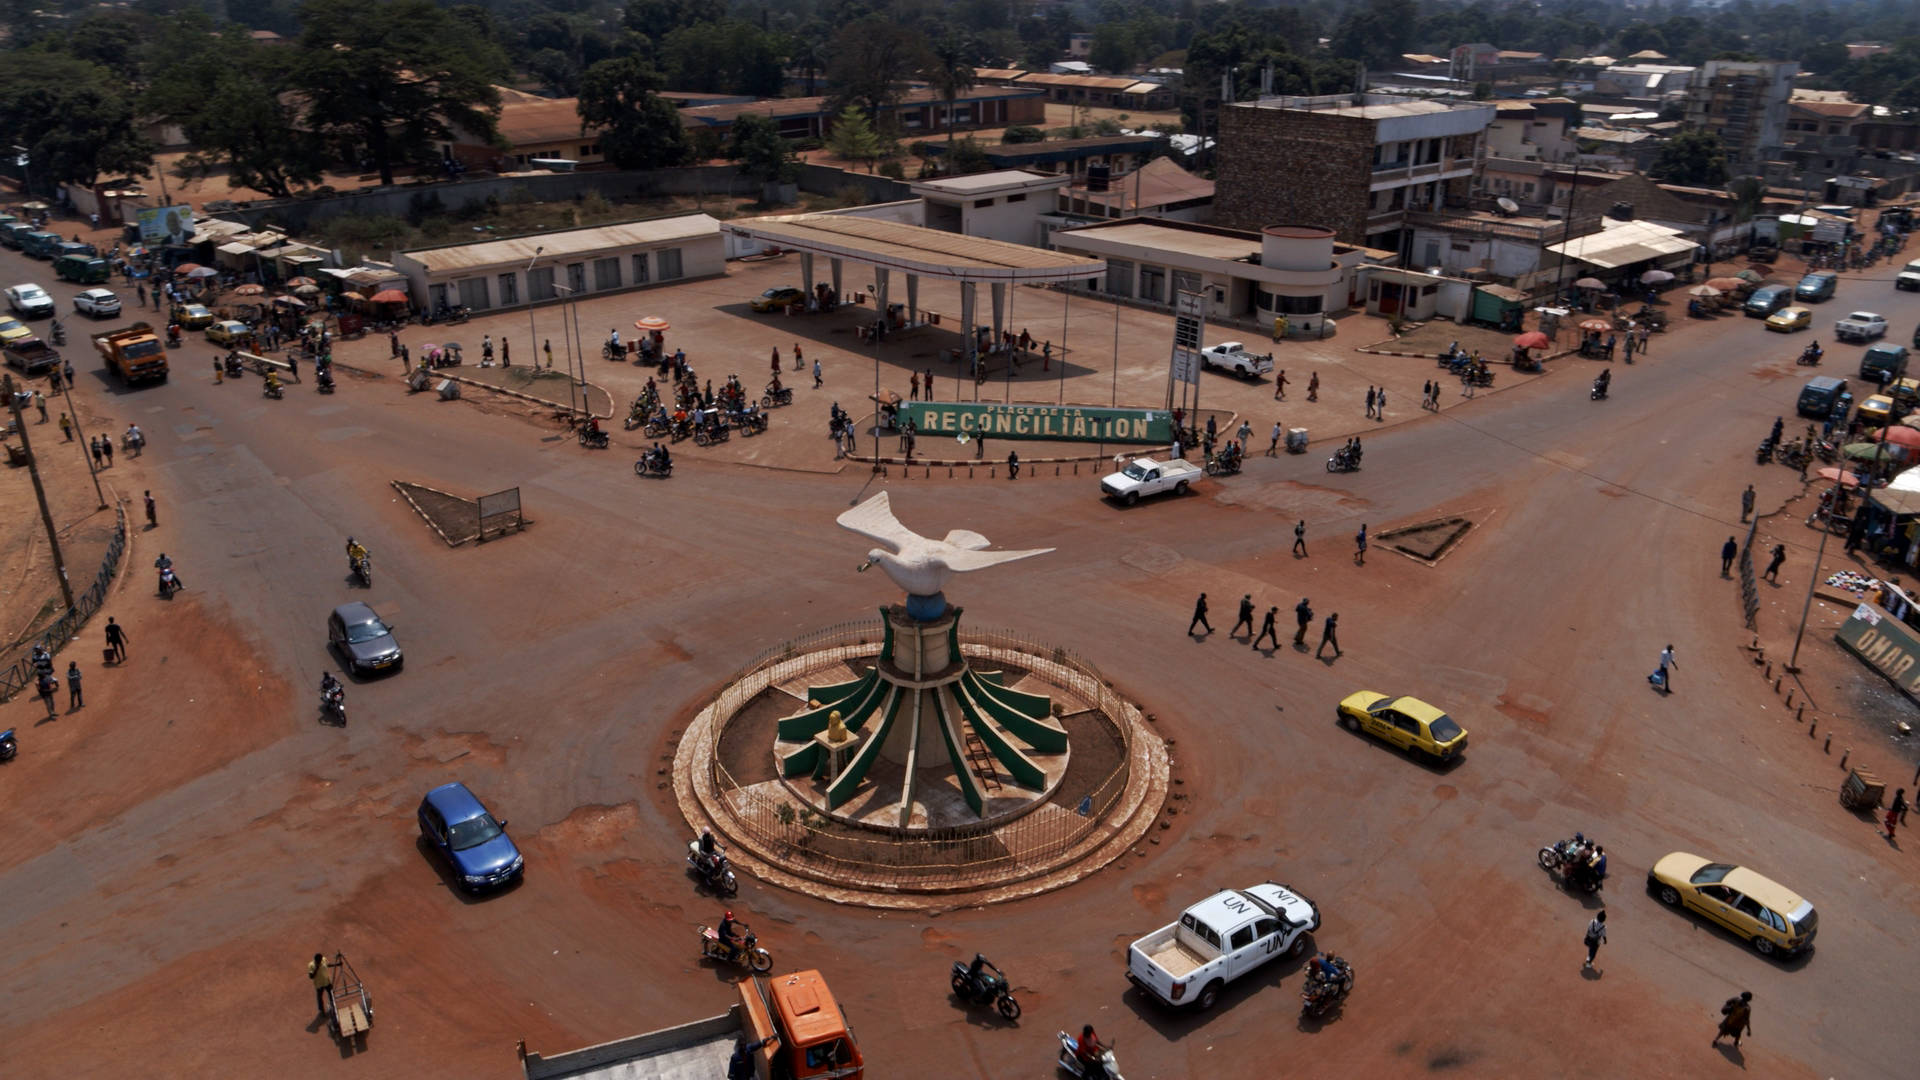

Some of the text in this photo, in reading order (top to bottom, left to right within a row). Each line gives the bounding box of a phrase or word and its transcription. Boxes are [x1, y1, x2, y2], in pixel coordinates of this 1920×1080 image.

[987, 406, 1081, 417] PLACE DE LA
[924, 411, 1147, 438] RECONCILIATION
[1856, 628, 1915, 680] OMAR
[1223, 896, 1251, 914] UN
[1272, 890, 1298, 905] UN
[1266, 933, 1285, 954] UN
